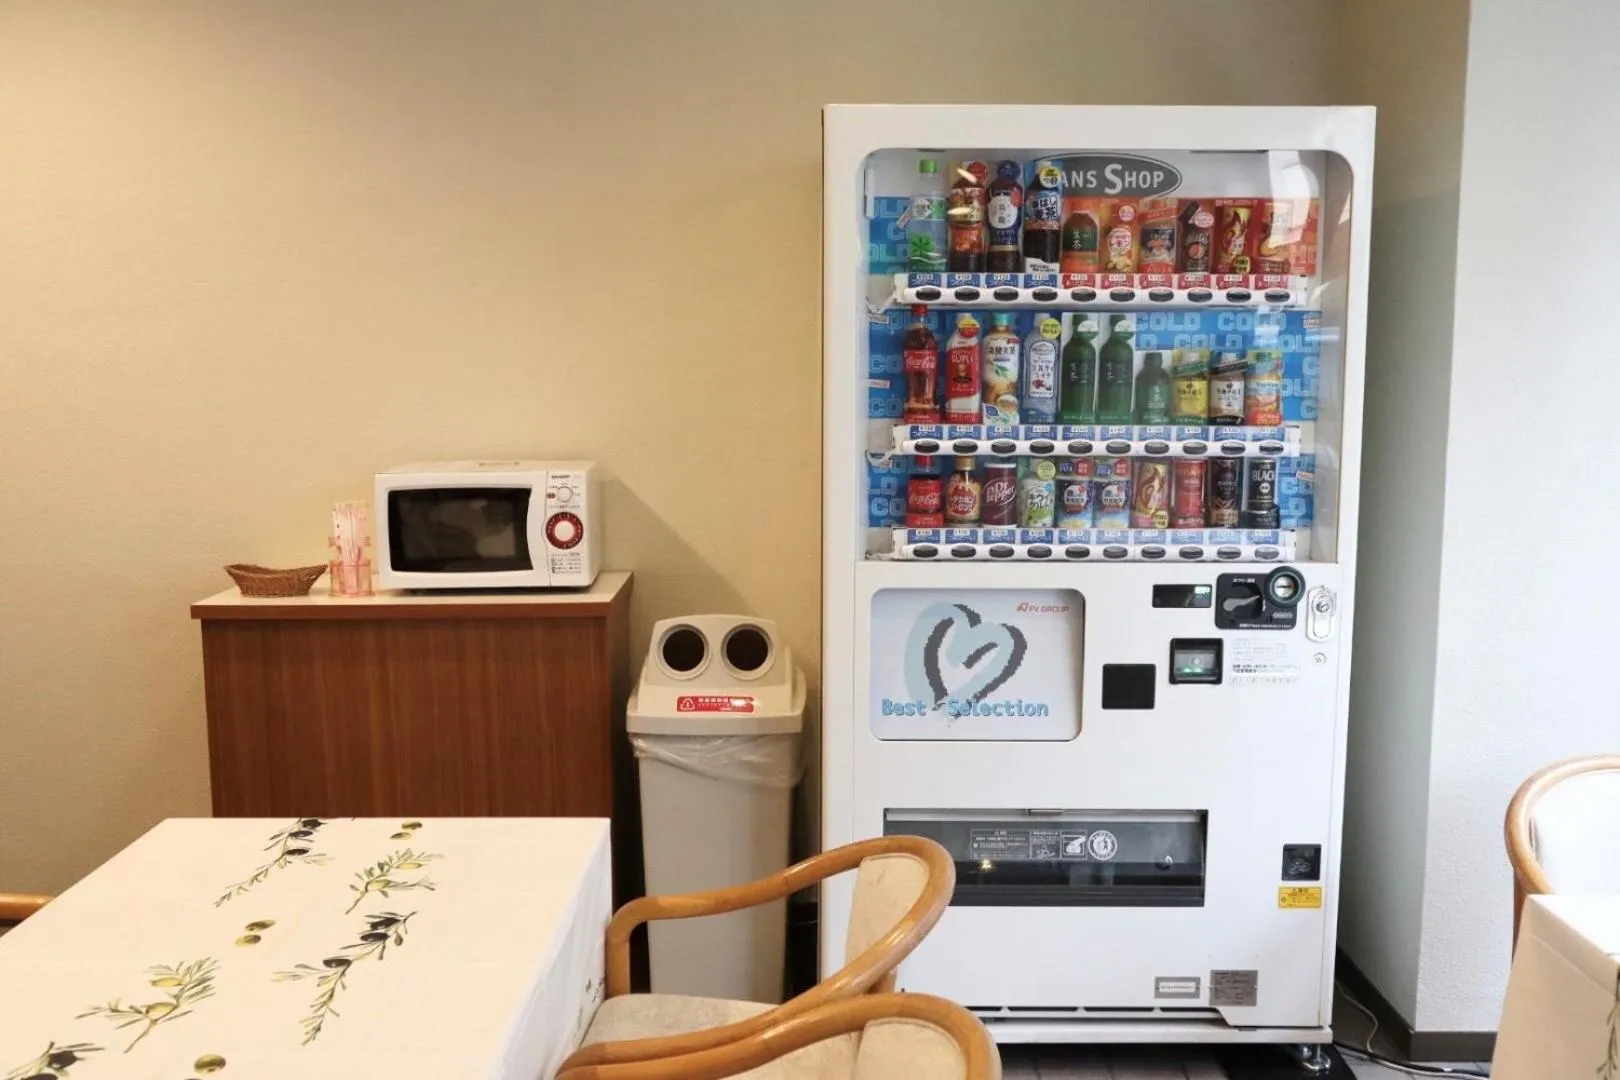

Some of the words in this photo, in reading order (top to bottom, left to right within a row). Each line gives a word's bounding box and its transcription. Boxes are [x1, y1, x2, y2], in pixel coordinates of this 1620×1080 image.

[1103, 163, 1165, 195] SHOP
[1136, 311, 1201, 331] COLD
[986, 485, 1015, 503] Pepper
[995, 481, 1009, 493] Dr
[881, 698, 927, 717] Best
[947, 698, 1049, 717] Selection
